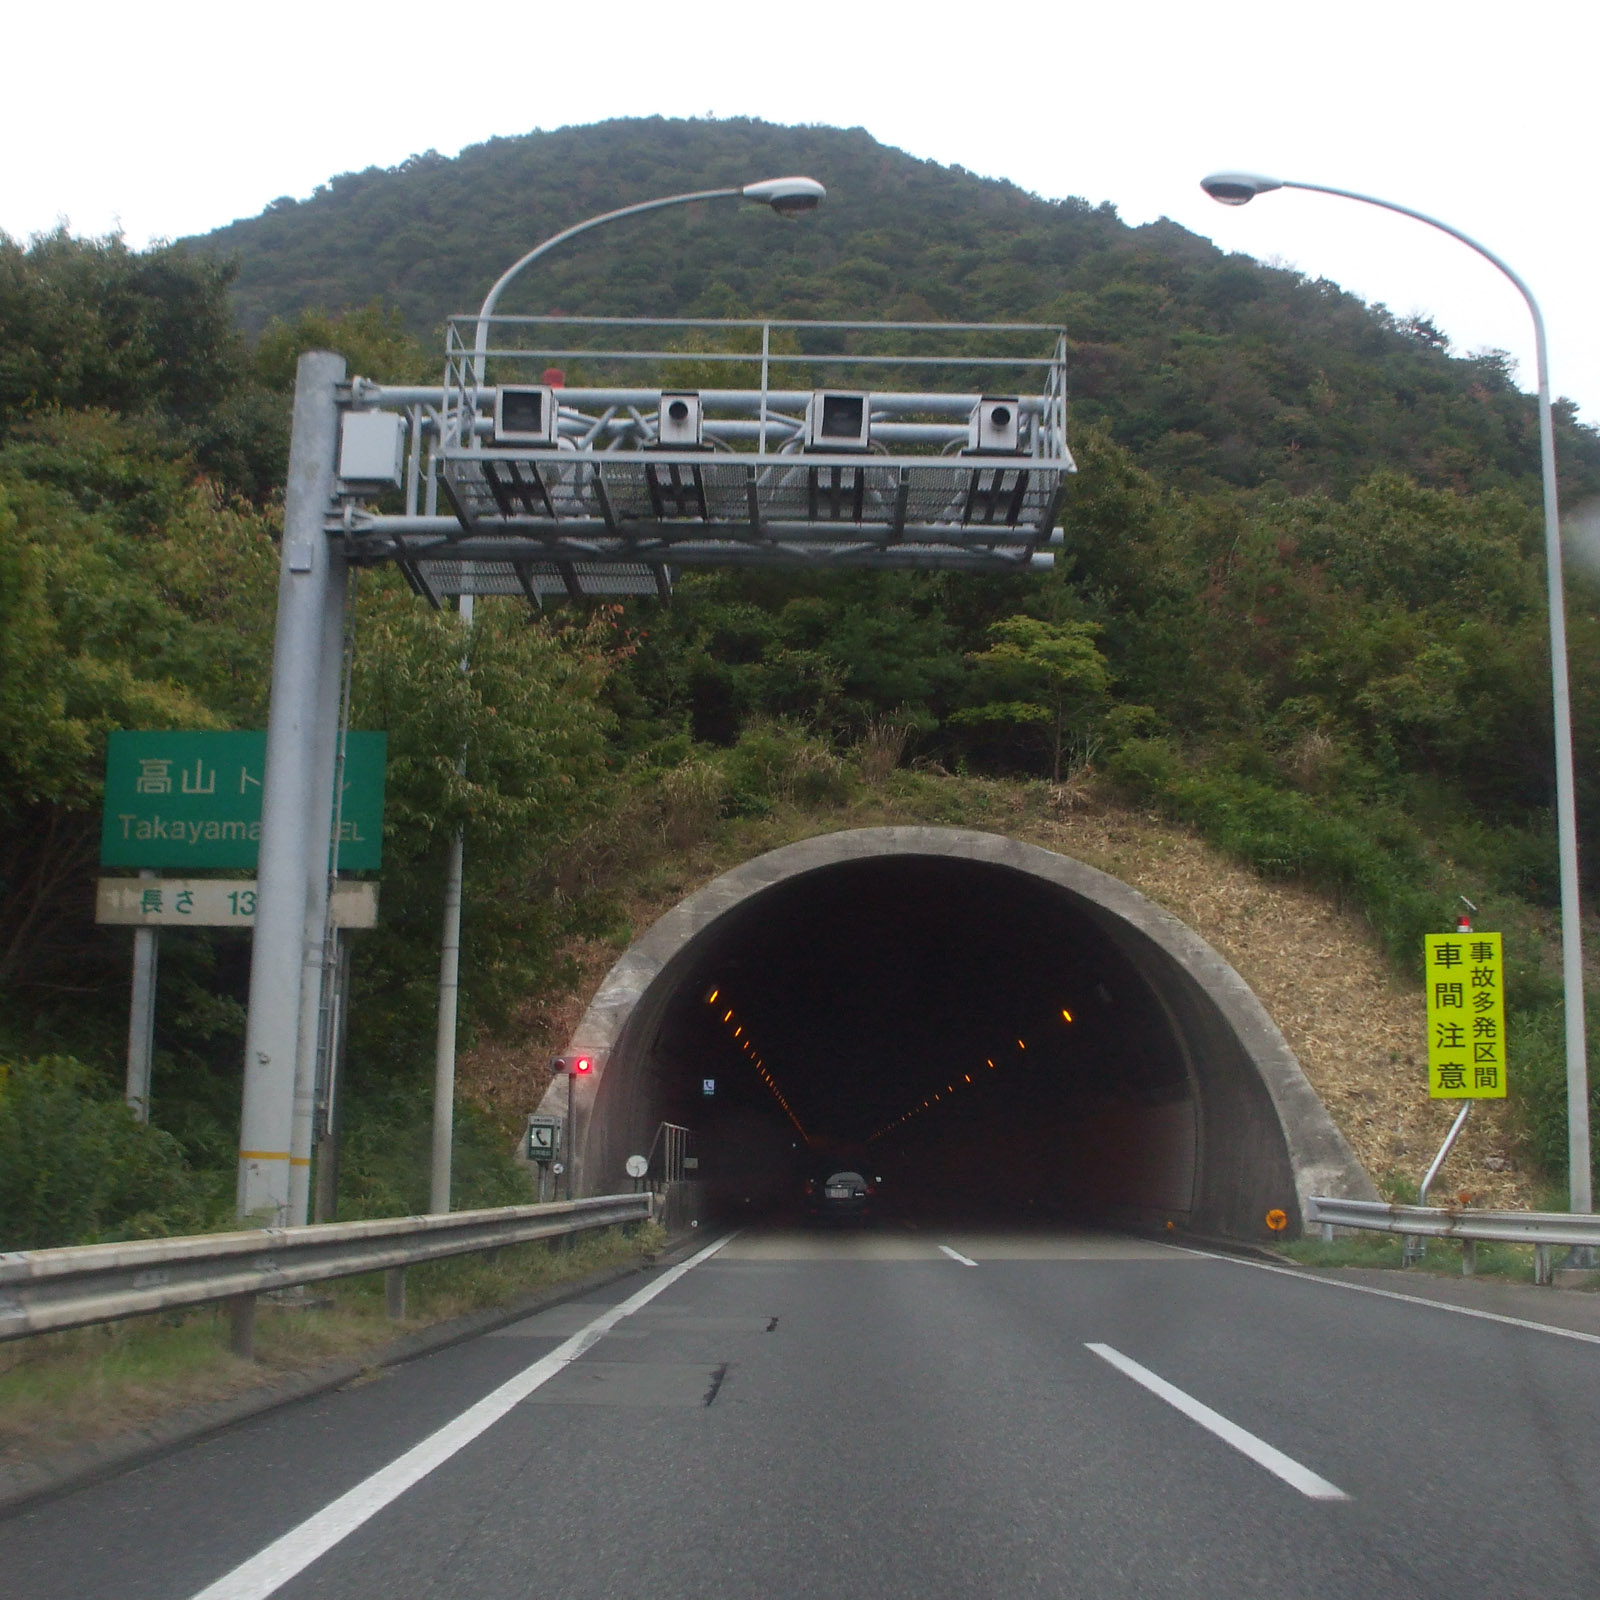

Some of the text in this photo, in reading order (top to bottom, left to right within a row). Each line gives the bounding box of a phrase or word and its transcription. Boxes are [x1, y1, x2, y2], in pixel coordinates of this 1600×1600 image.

[118, 814, 261, 844] Takayama
[140, 889, 194, 915] 長さ
[1433, 942, 1467, 1089] 車間注意
[1469, 941, 1498, 1089] 事故多発区間
